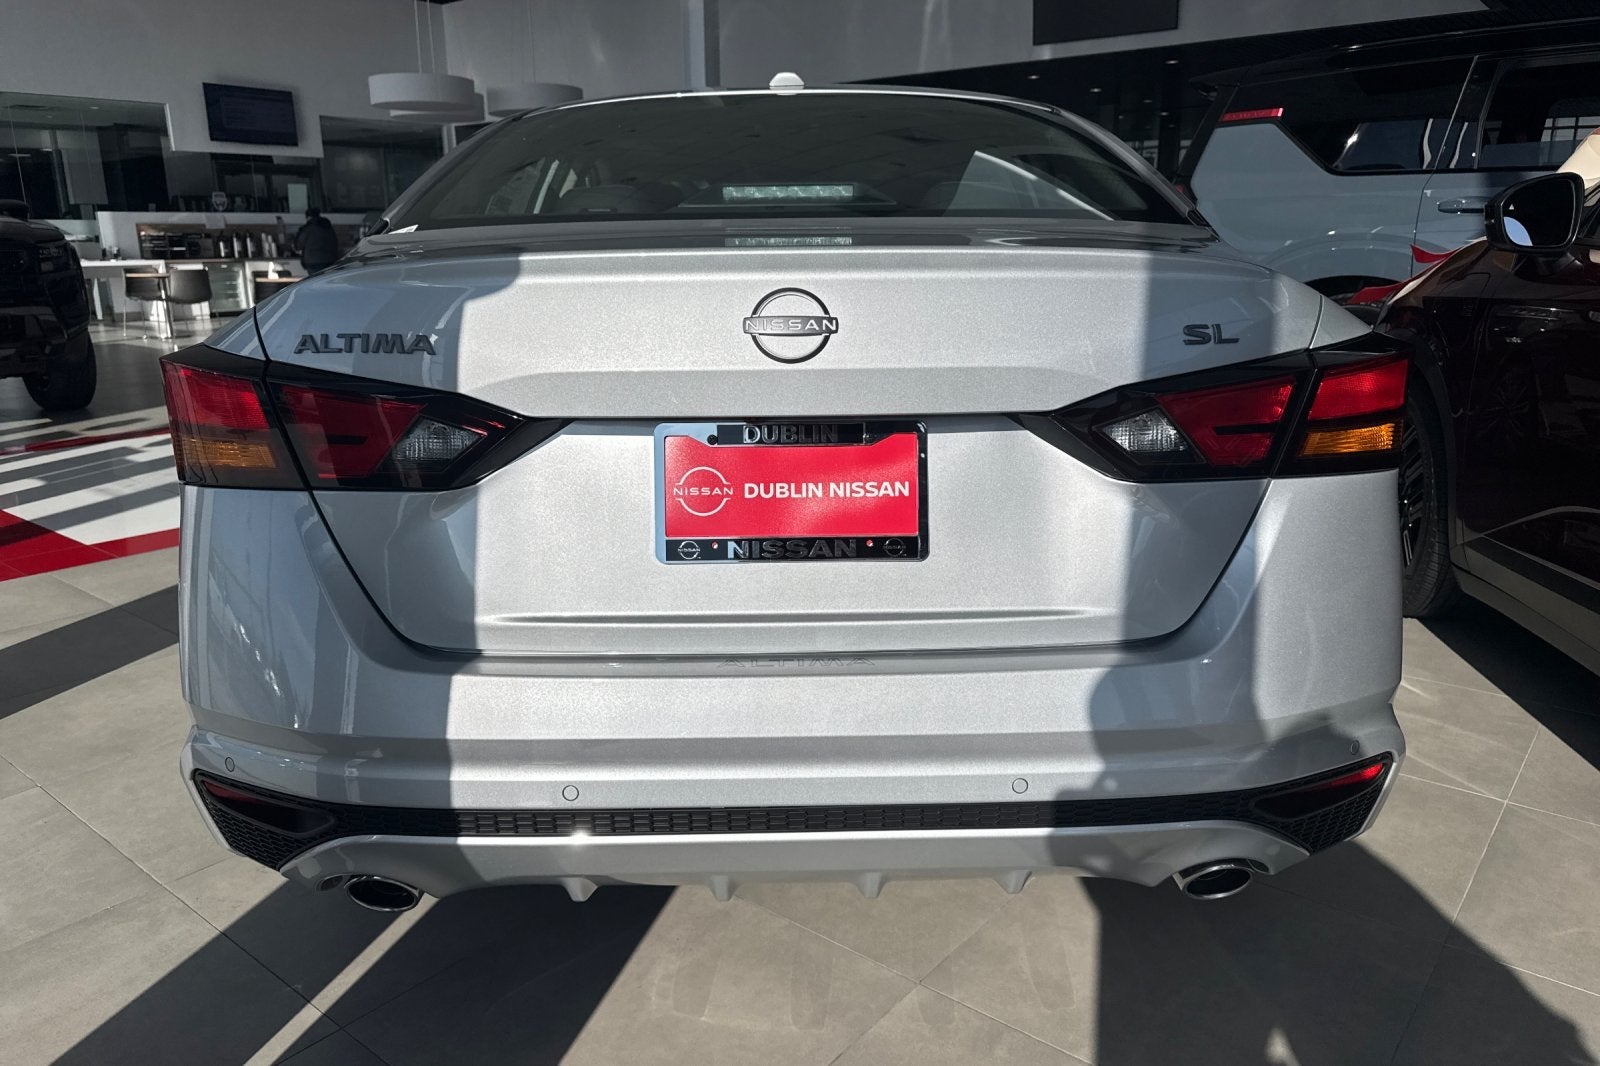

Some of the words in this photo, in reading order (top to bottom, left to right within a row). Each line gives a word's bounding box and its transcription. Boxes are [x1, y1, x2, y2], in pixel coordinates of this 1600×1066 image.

[745, 319, 836, 331] NISSAN
[1183, 323, 1240, 346] SL
[294, 332, 437, 356] ALTIMA
[743, 424, 839, 444] DUBLIN
[673, 486, 734, 496] NISSAN
[744, 482, 823, 499] DUBLIN
[829, 481, 910, 498] NISSAN
[727, 539, 857, 559] NISSAN
[717, 657, 875, 667] ALTIMA
